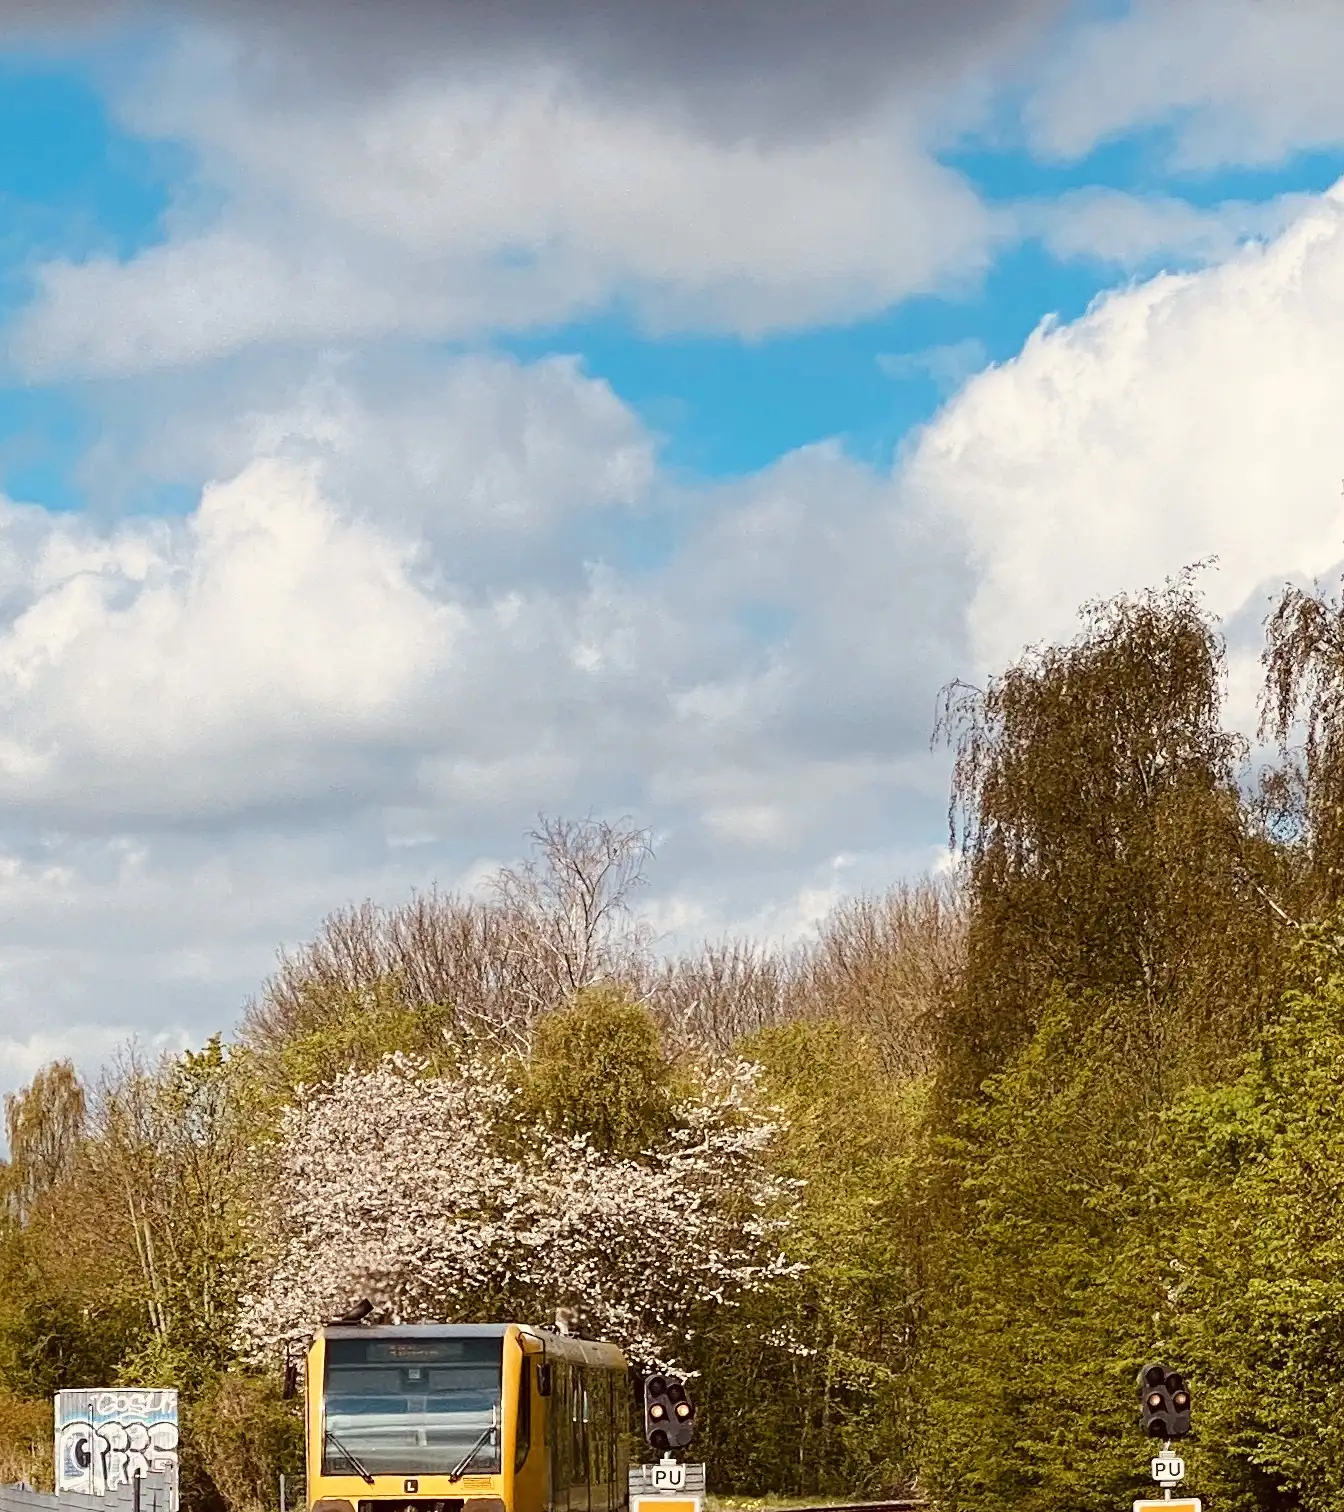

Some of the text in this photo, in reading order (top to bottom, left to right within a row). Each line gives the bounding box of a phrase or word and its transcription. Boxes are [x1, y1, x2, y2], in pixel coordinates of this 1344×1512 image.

[1155, 1462, 1181, 1477] PU
[655, 1470, 681, 1485] PU
[407, 1481, 416, 1492] L
